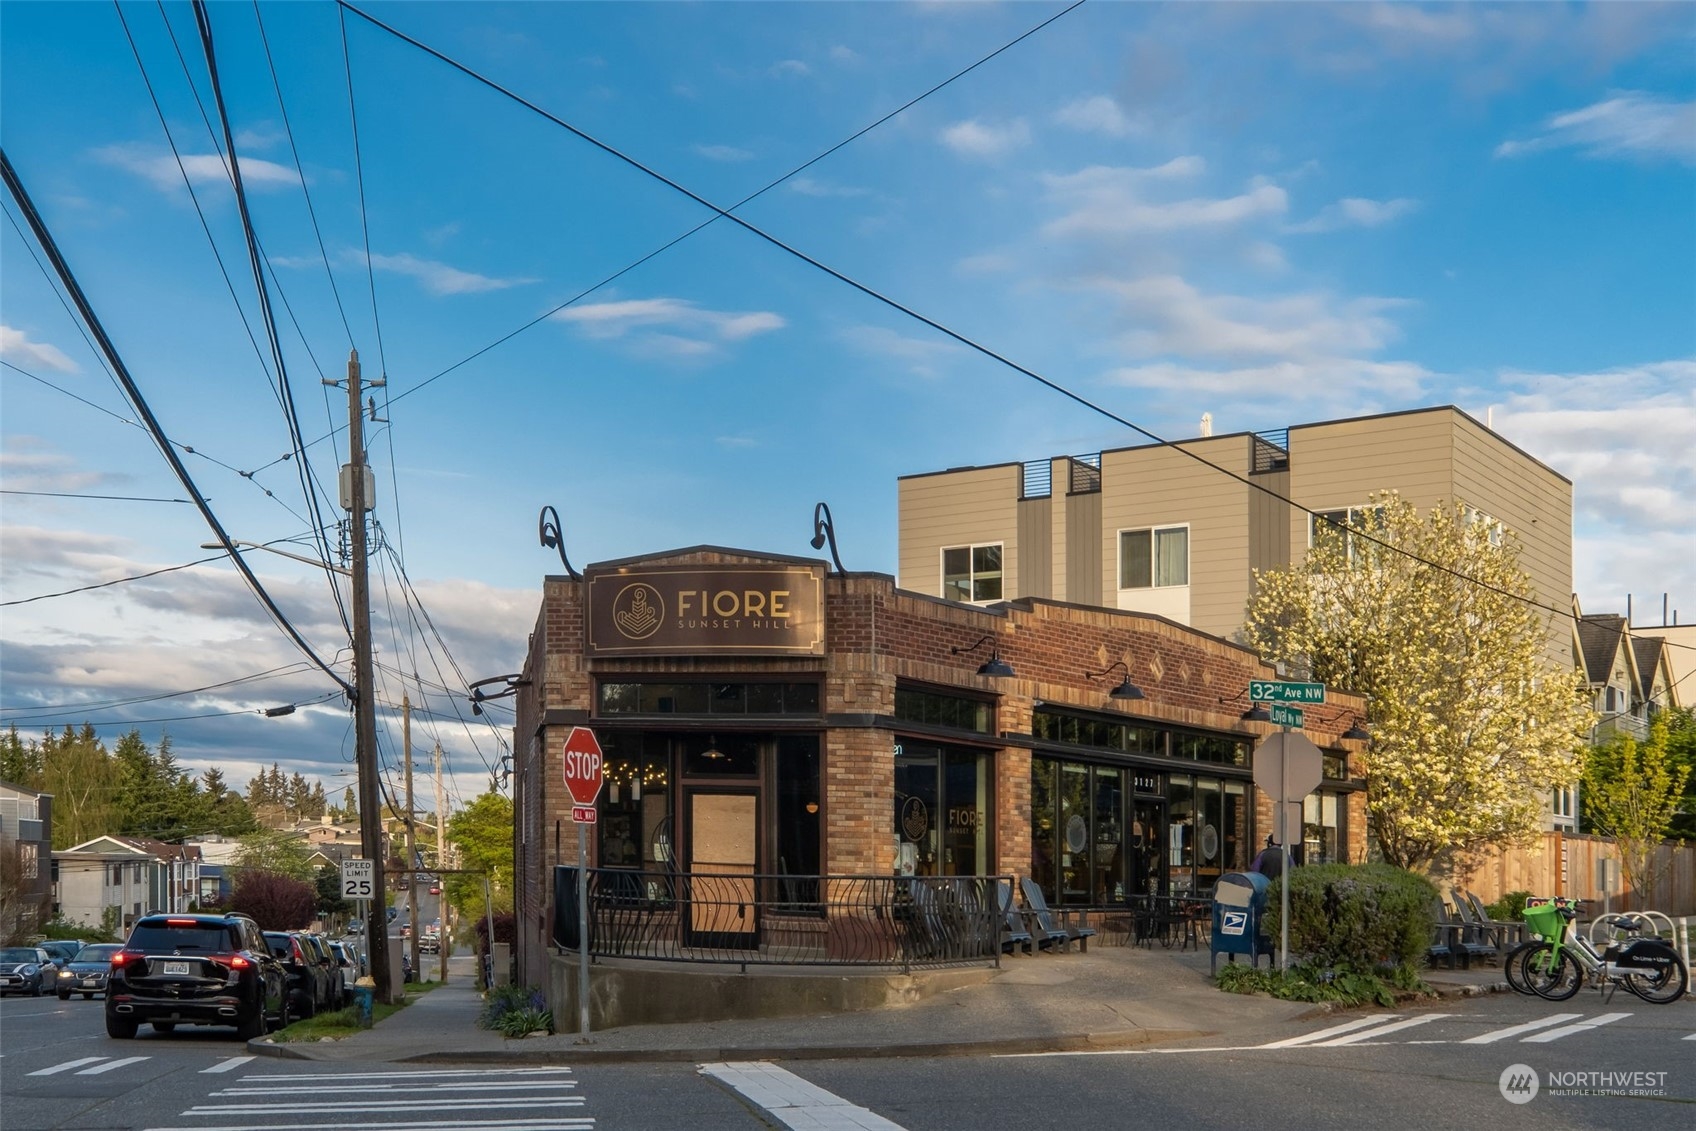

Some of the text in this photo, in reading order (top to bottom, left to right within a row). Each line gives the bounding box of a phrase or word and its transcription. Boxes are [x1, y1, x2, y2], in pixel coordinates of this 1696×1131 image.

[678, 590, 790, 618] FIORE
[678, 619, 790, 629] SUNSET HILL
[1253, 683, 1322, 699] 32nd Ave NW
[1272, 706, 1287, 725] Loyal
[893, 744, 903, 755] en
[566, 750, 600, 780] STOP
[1134, 776, 1153, 787] 3127
[574, 809, 595, 821] ALL WAY
[949, 809, 984, 826] FIORE
[345, 880, 371, 895] 25
